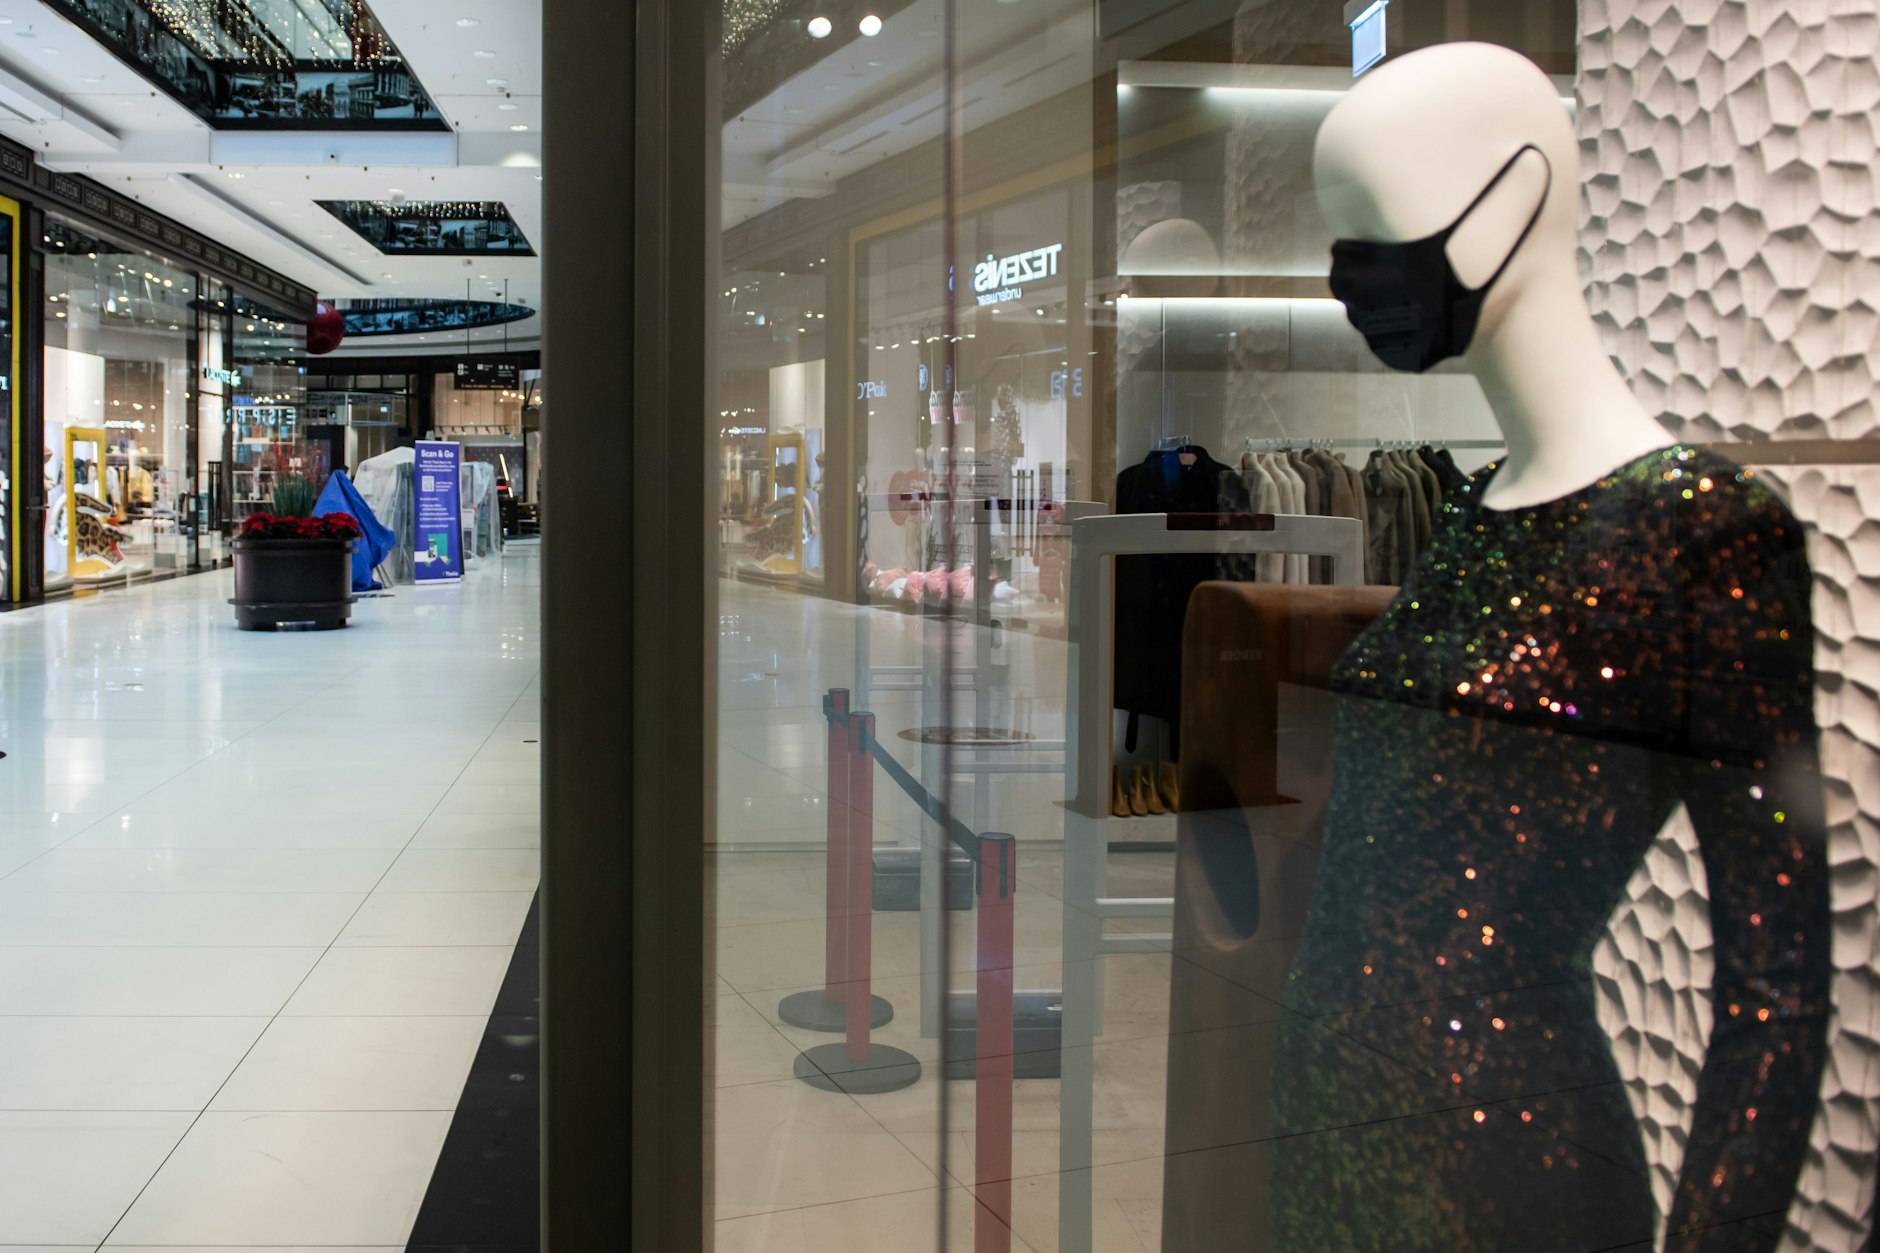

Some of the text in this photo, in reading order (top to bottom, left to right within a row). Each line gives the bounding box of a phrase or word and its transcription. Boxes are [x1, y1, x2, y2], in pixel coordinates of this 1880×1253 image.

[421, 449, 454, 458] Scan & Go
